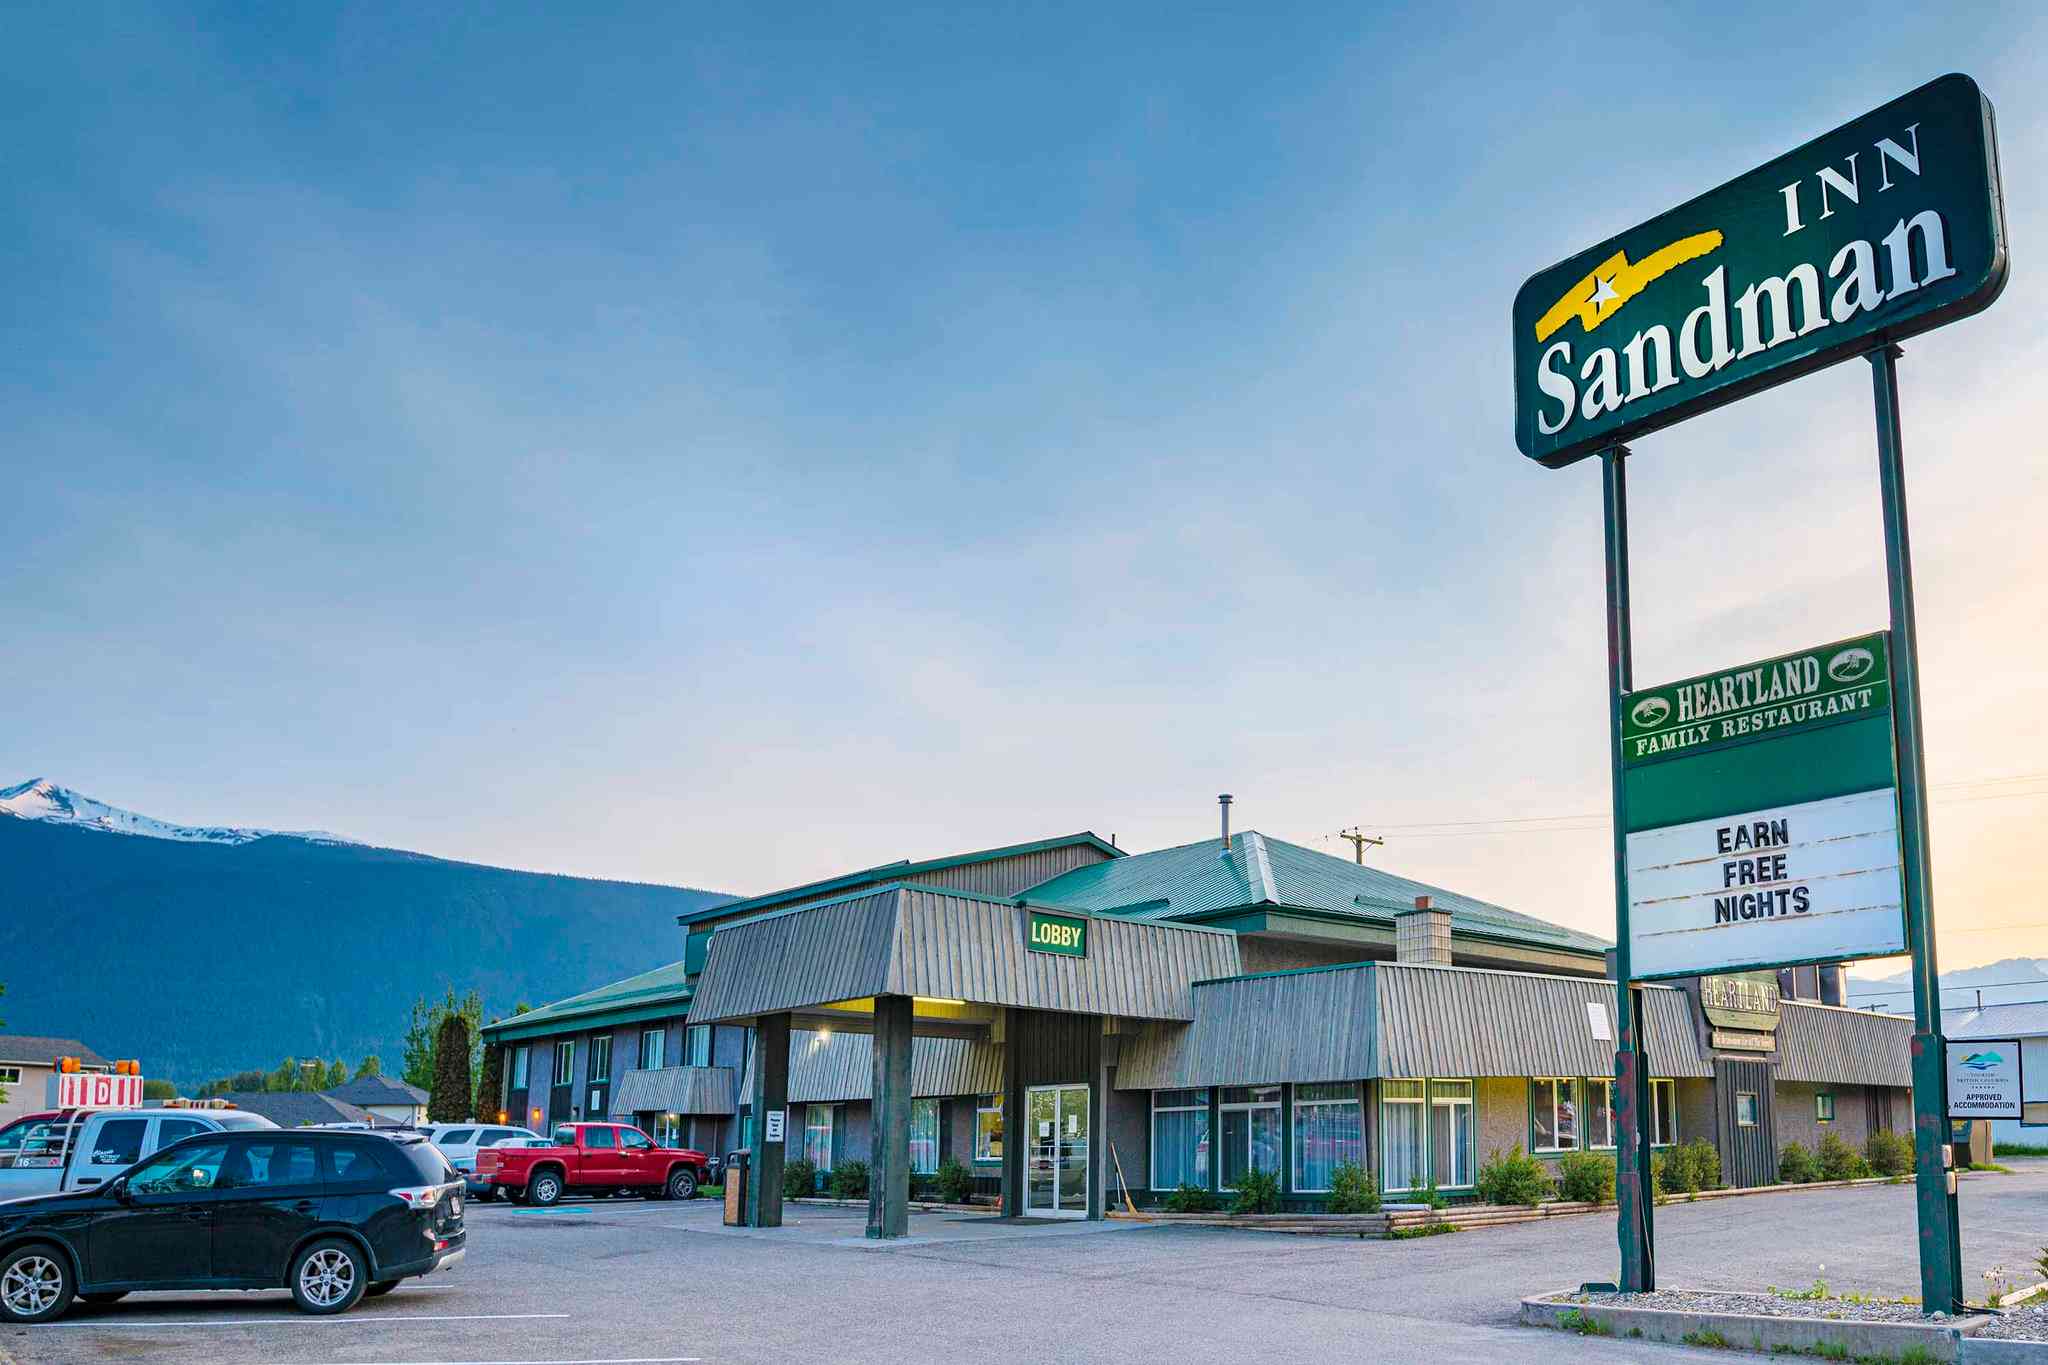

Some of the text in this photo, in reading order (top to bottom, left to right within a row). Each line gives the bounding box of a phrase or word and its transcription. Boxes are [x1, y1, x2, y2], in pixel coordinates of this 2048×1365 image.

[1778, 122, 1921, 237] INN
[1537, 208, 1956, 435] Sandman
[1677, 655, 1821, 723] HEARTLAND
[1636, 689, 1873, 757] FAMILY RESTAURANT
[1716, 818, 1789, 854] EARN
[1723, 853, 1788, 888] FREE
[1714, 886, 1810, 924] NIGHTS
[1032, 921, 1081, 947] LOBBY
[1702, 975, 1778, 1013] HEARTLAND
[1953, 1101, 2016, 1109] ACCOMMODATION
[1966, 1093, 2002, 1101] APPROVED
